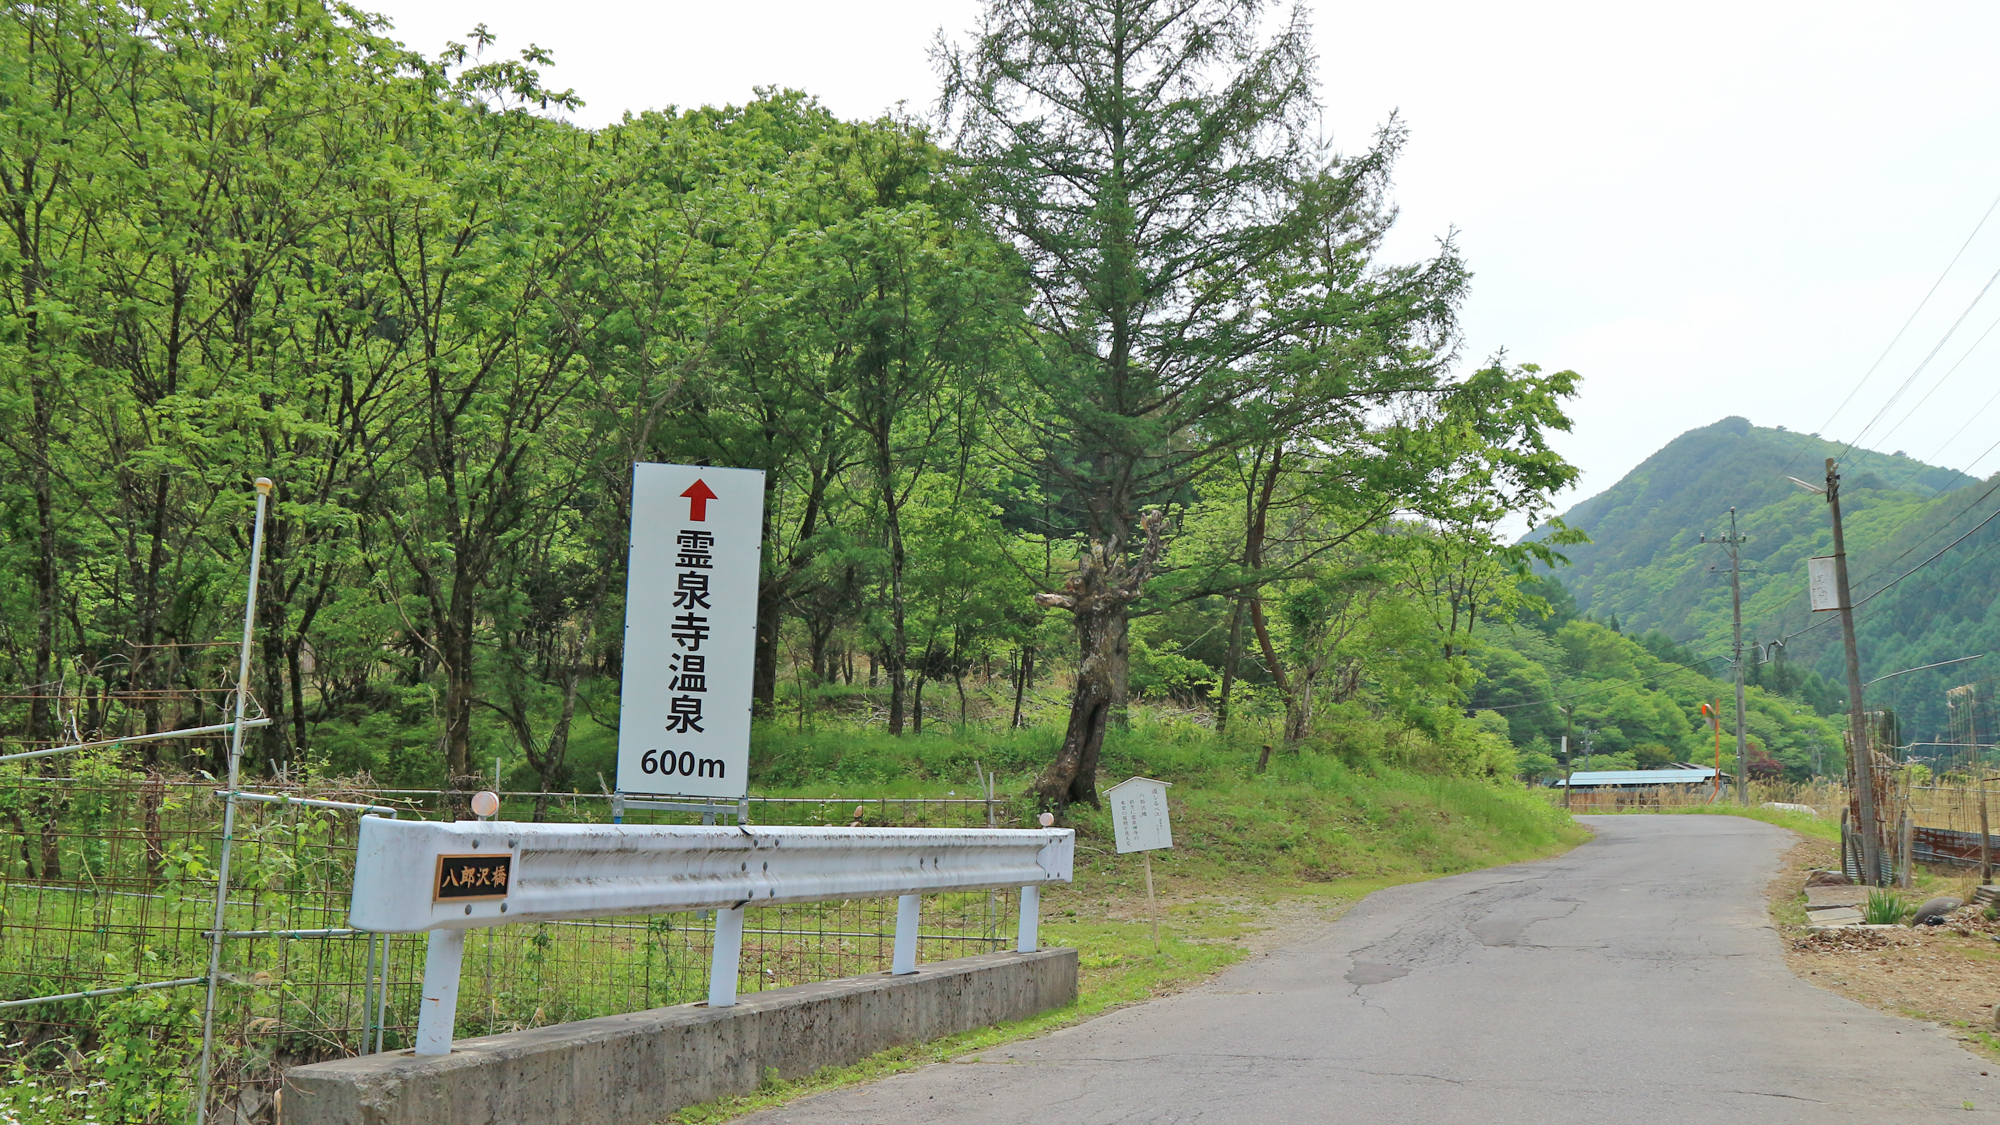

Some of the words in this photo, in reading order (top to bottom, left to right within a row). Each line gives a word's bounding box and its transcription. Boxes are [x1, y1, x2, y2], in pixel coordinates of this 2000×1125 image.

[665, 529, 715, 734] 霊泉寺温泉
[641, 749, 725, 779] 600m
[442, 866, 507, 888] 八郎沢橋
